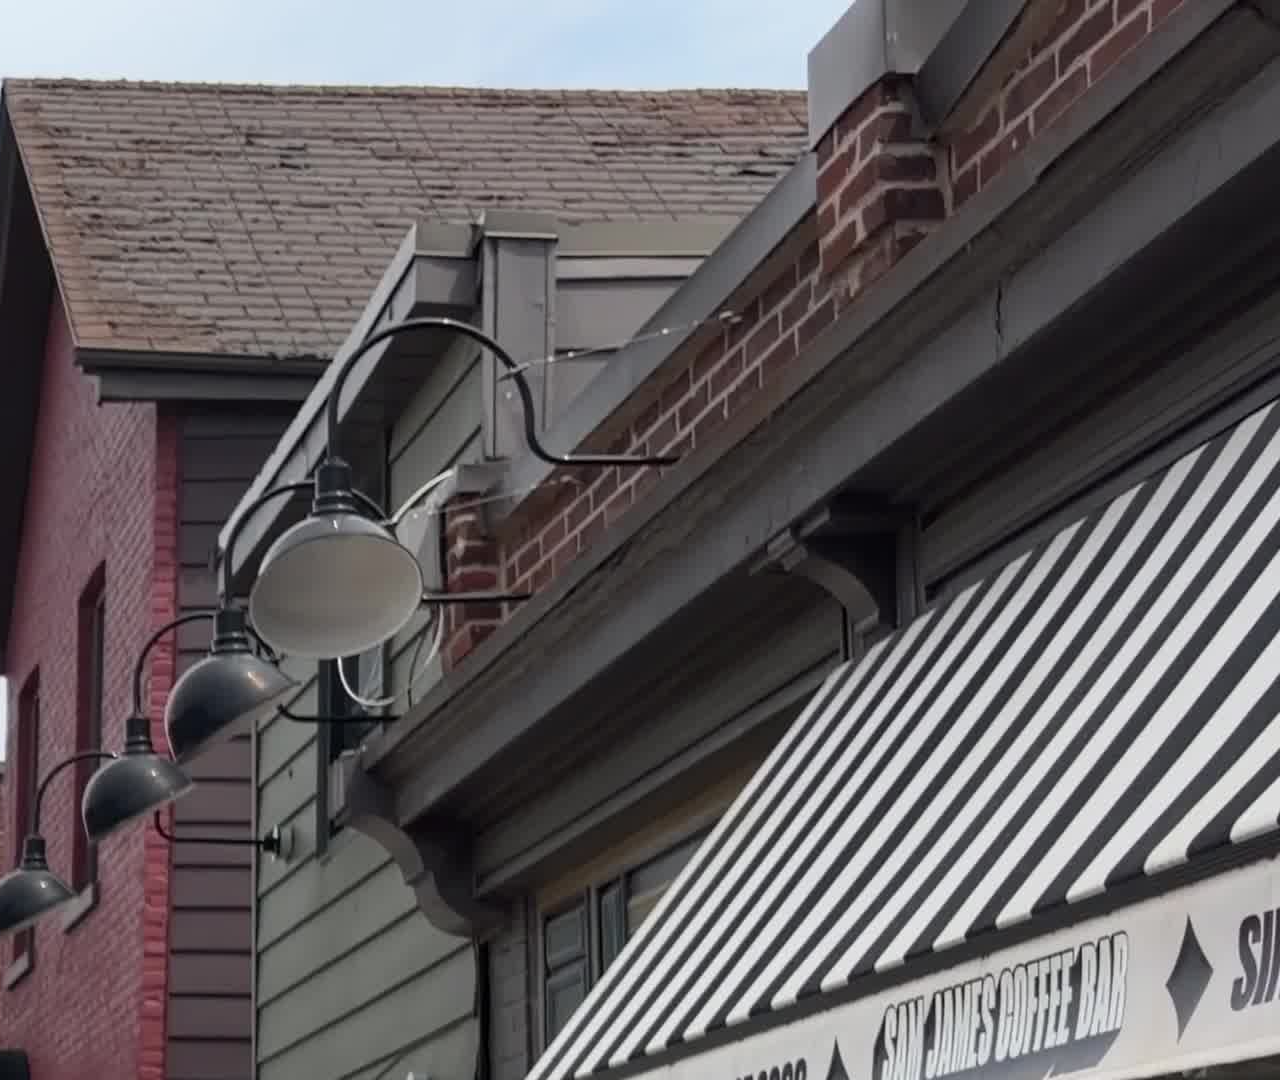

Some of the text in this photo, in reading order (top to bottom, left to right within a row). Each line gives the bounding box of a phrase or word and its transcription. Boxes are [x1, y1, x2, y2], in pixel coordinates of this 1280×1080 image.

[924, 973, 996, 1080] JAMES
[994, 948, 1077, 1062] COFFEE
[1074, 930, 1129, 1040] BAR
